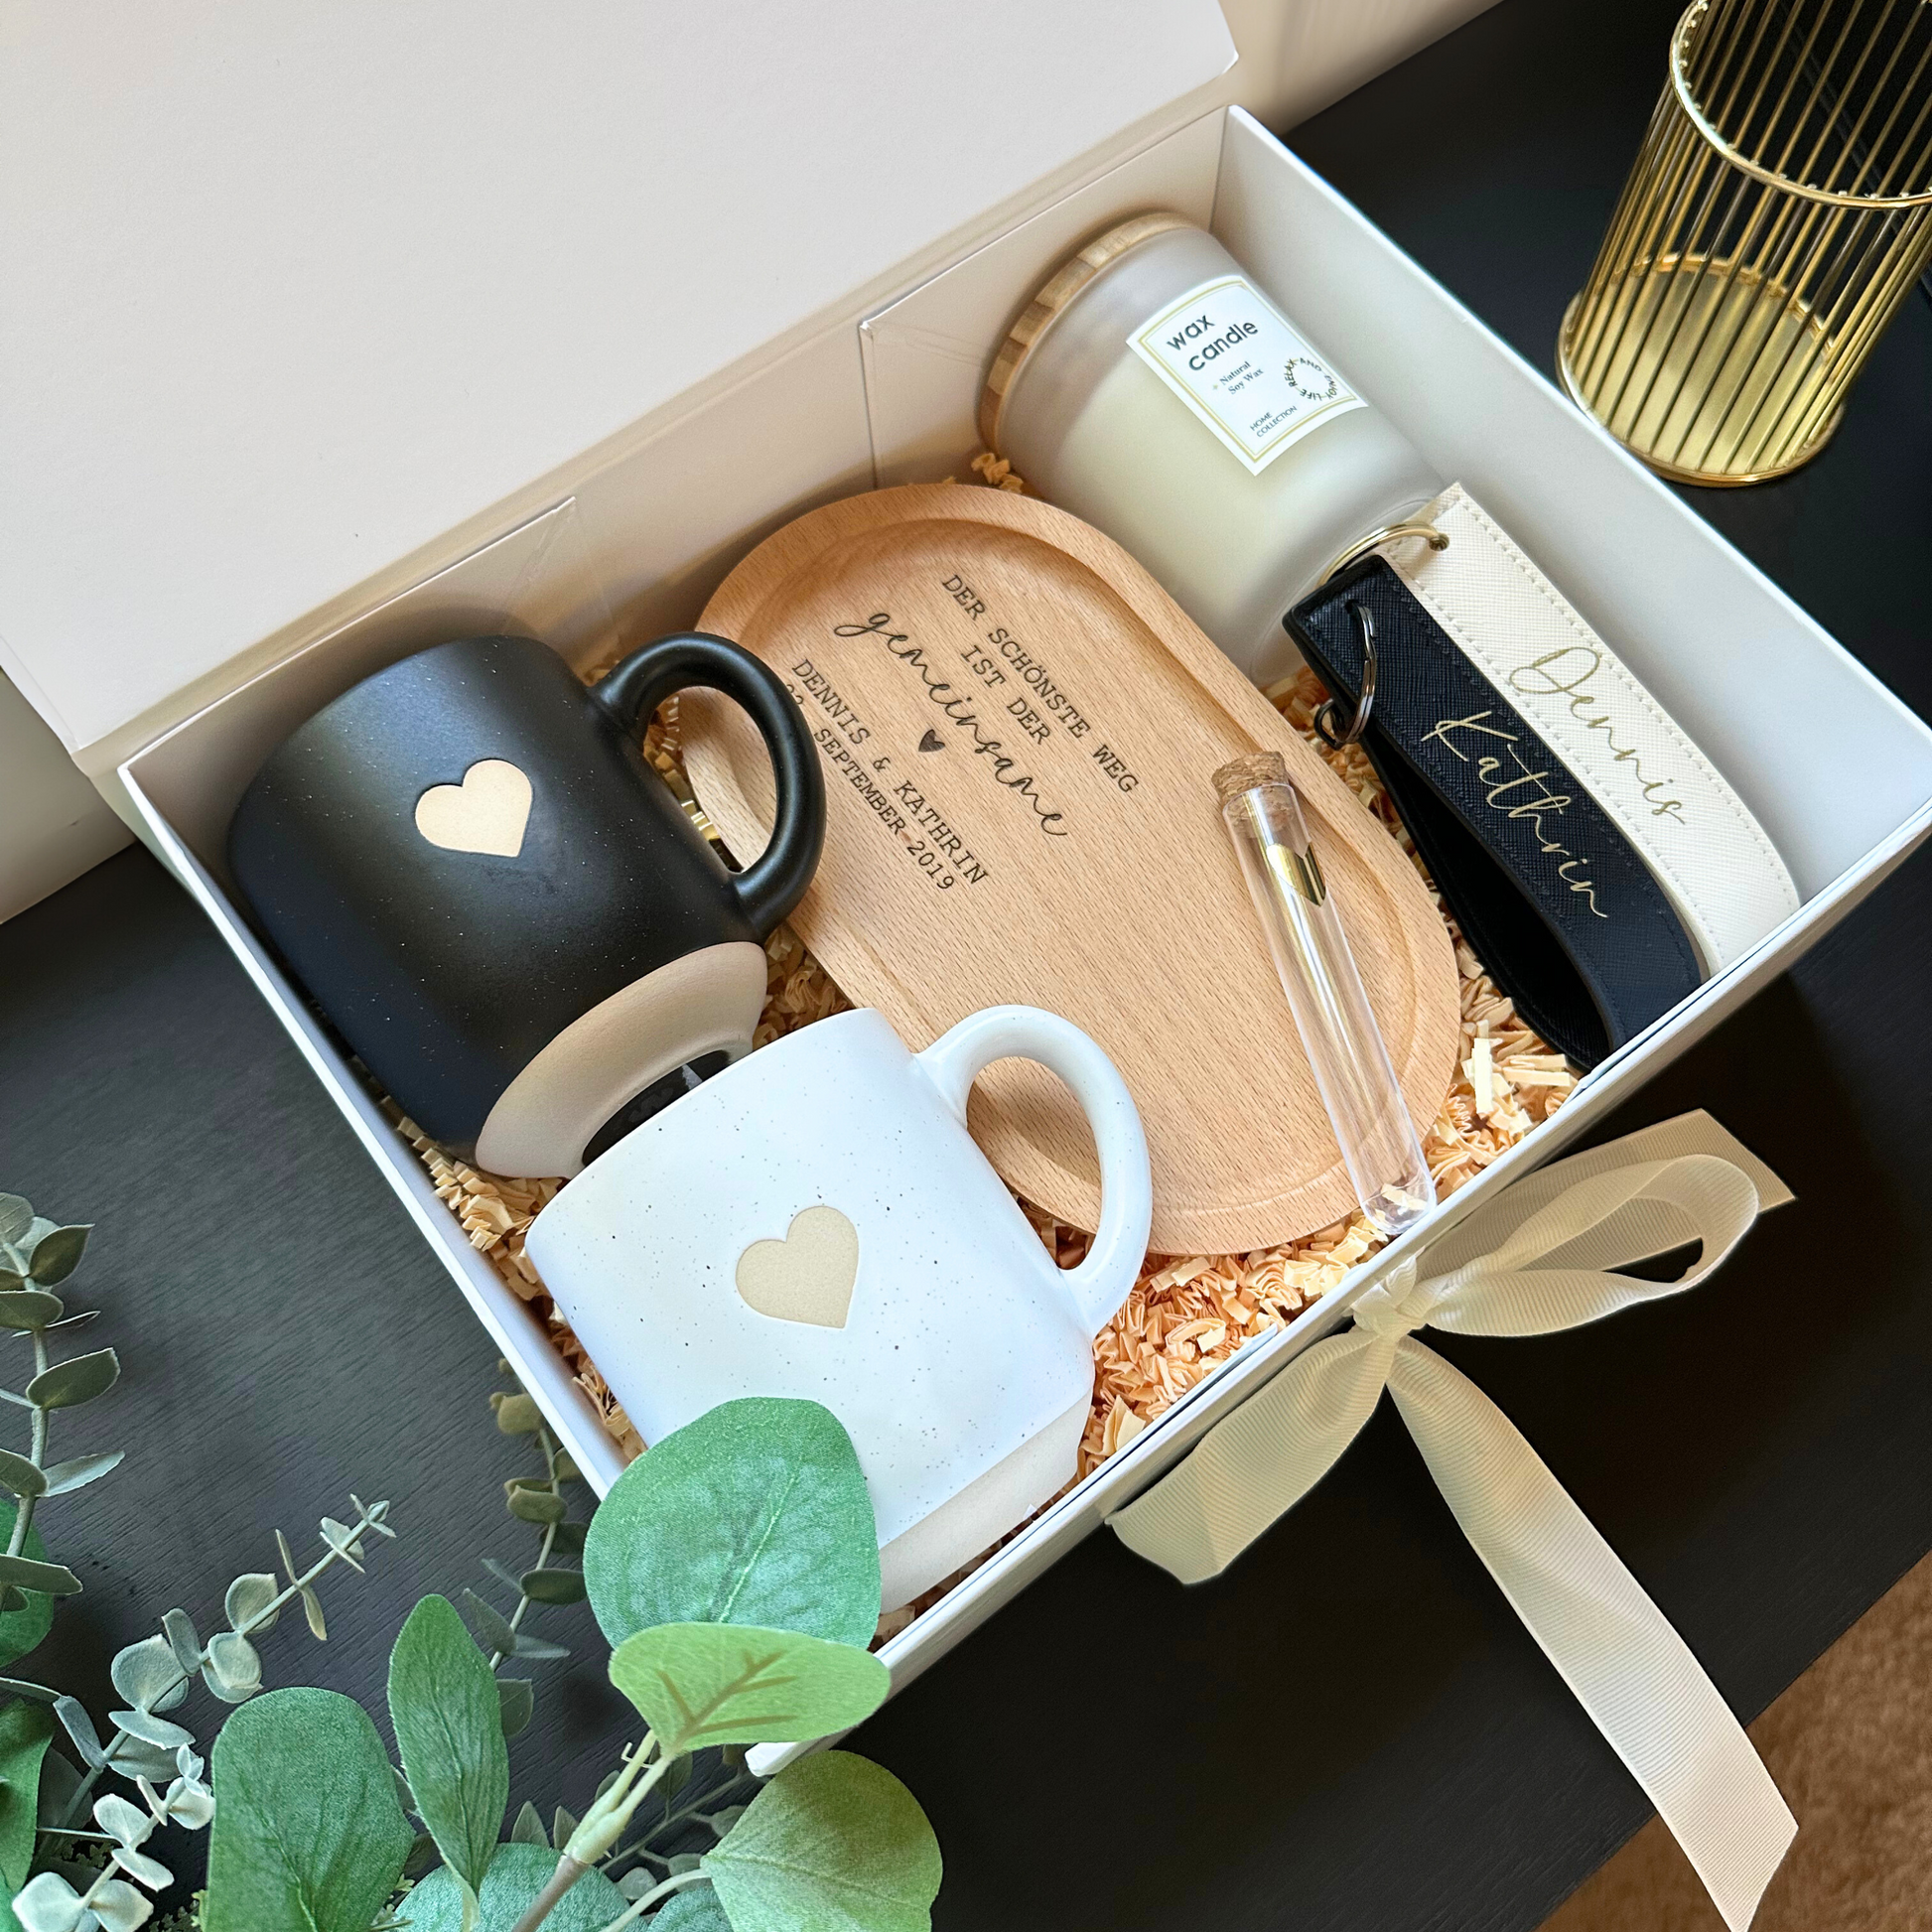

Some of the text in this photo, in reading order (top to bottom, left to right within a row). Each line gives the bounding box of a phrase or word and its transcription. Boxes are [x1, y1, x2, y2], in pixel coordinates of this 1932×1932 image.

[1166, 315, 1215, 350] wax
[1188, 321, 1259, 371] candle
[1219, 360, 1251, 386] Natural
[1227, 367, 1264, 395] Soy Wax
[1284, 358, 1298, 387] RELAX
[1300, 357, 1322, 372] AND
[1300, 388, 1322, 401] LIFE
[1250, 412, 1273, 432] HOME
[1256, 405, 1298, 438] COLLECTION
[942, 575, 1139, 793] DER SCHÖNSTE WEG
[960, 645, 1052, 746] IST DER
[834, 613, 1067, 836] gemeinsame
[1509, 646, 1686, 825] Dennis
[791, 659, 990, 885] DENNIS & KATHRIN
[814, 728, 955, 891] SEPTEMBER 2019
[1421, 710, 1608, 918] Kathrin
